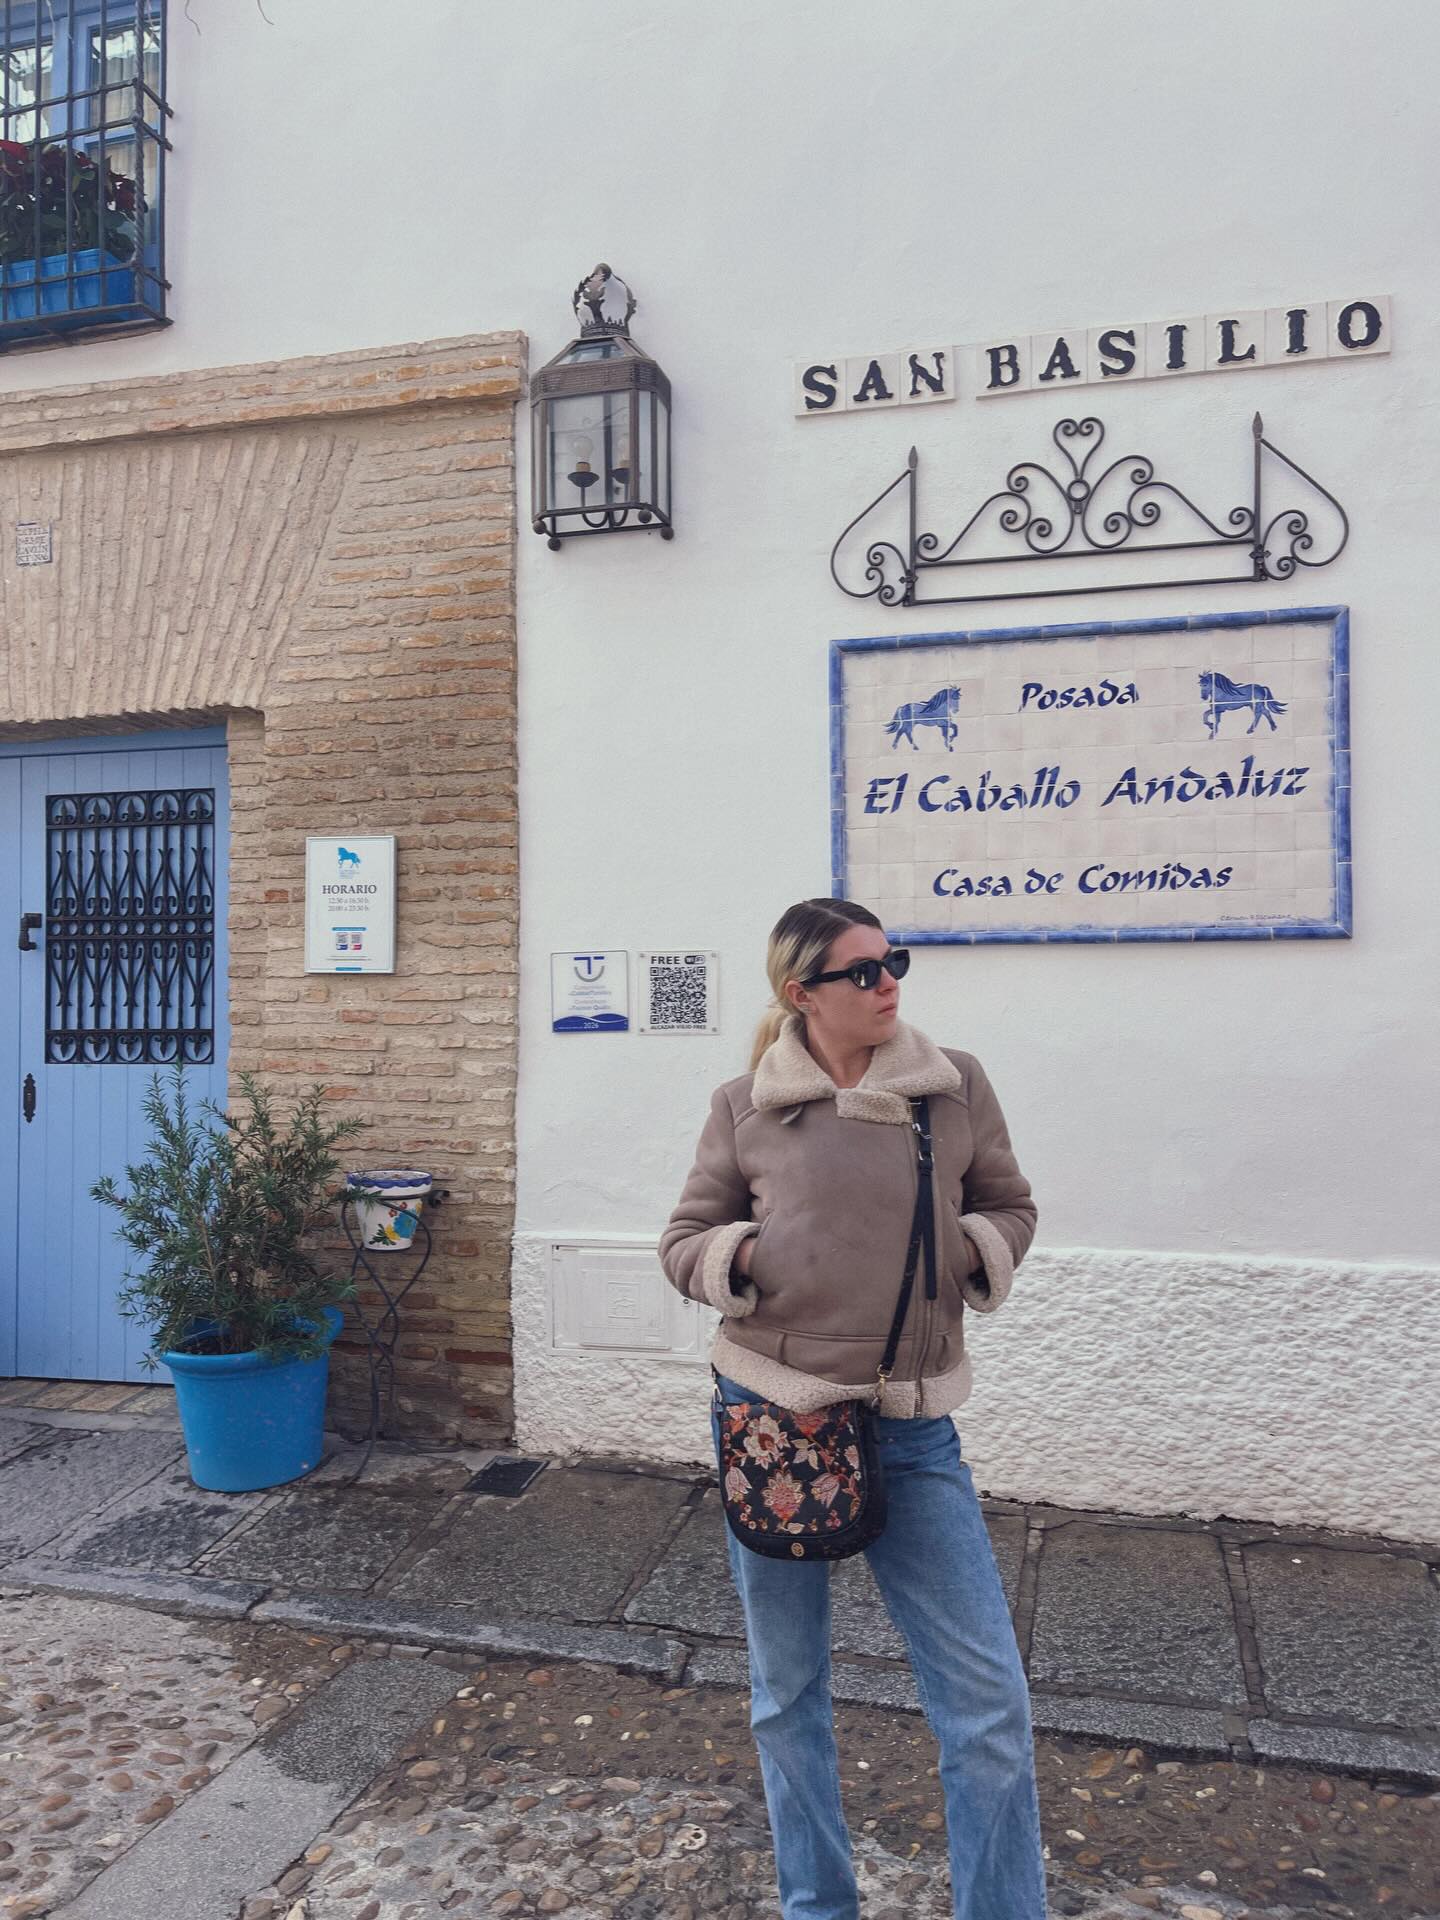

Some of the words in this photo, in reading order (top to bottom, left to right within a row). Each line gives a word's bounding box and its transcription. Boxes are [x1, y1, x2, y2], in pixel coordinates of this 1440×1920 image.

[801, 352, 945, 410] SAN
[985, 300, 1383, 389] BASILIO
[1018, 678, 1140, 713] Posada
[863, 772, 909, 815] El
[917, 765, 1081, 814] Caballo
[1100, 754, 1311, 808] Andaluz
[322, 885, 377, 895] HORARIO
[932, 868, 1013, 897] Casa
[1024, 867, 1064, 895] de
[1077, 862, 1234, 895] Comidas
[650, 955, 681, 965] FREE
